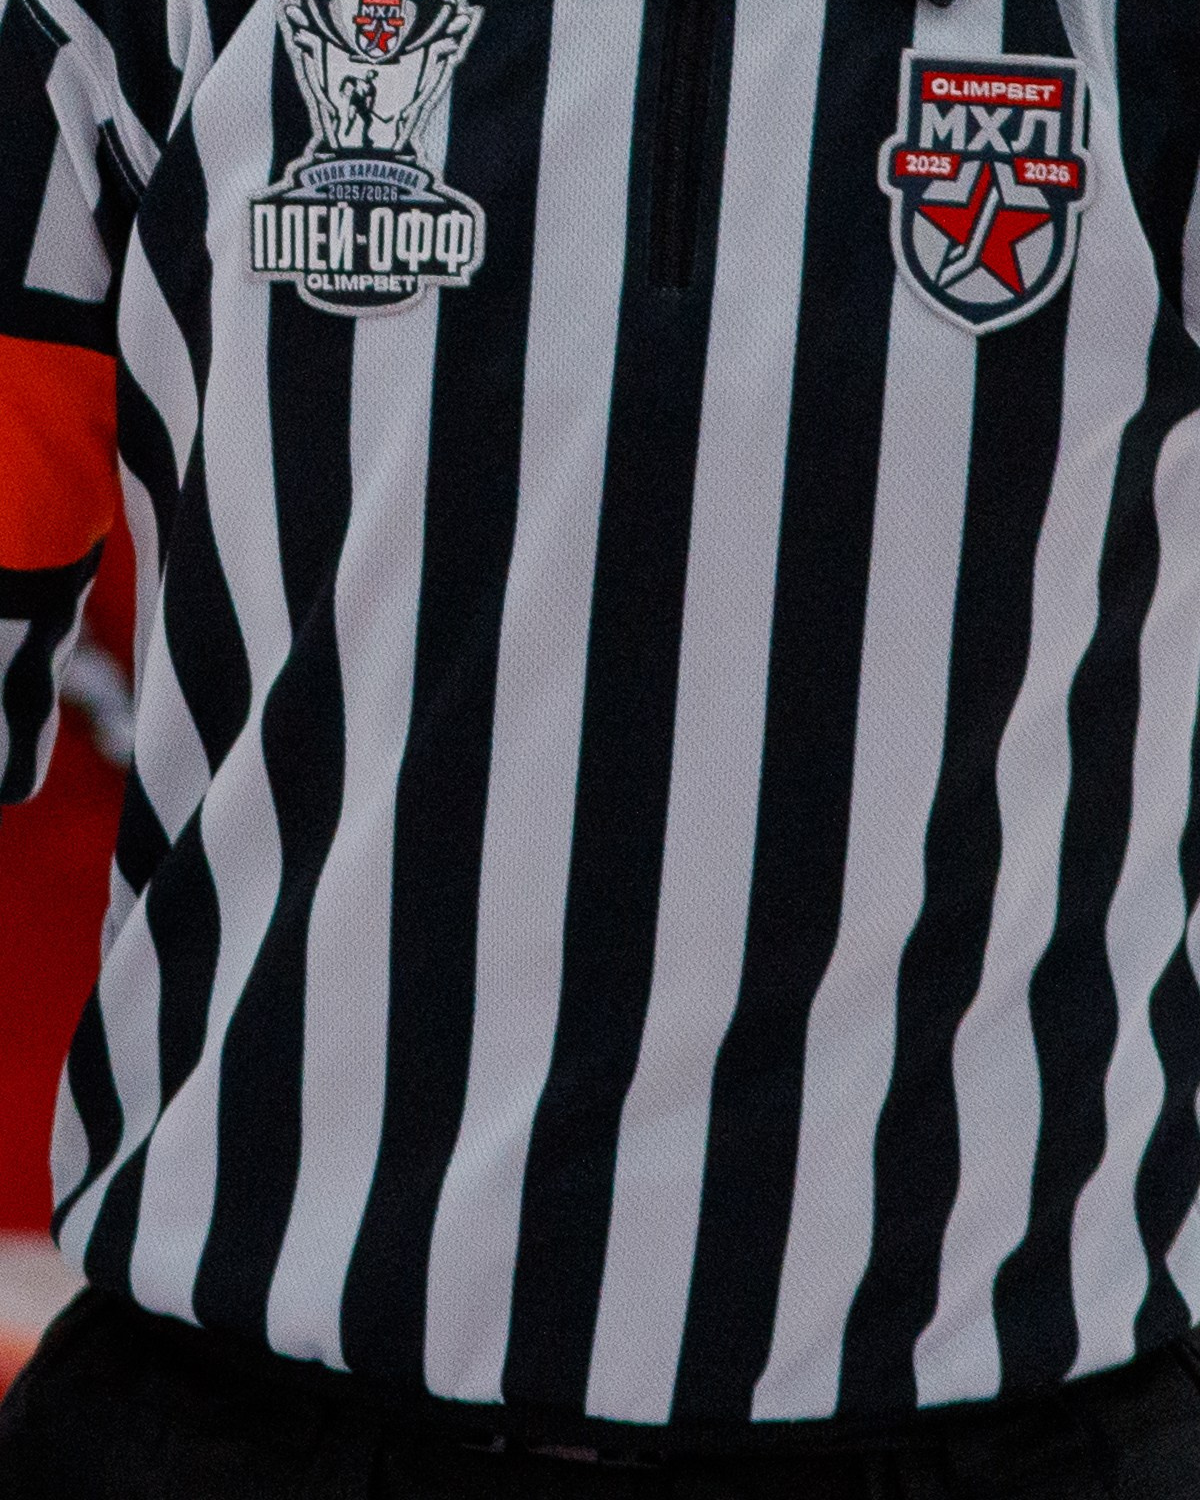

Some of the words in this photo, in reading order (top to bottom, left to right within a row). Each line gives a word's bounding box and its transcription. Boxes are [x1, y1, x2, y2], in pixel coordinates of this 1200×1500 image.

[362, 4, 400, 18] МХЛ
[931, 77, 1055, 100] OLIMPBET
[919, 102, 1061, 156] МХЛ
[906, 154, 951, 173] 2025
[1024, 162, 1071, 183] 2026
[328, 184, 398, 201] 2025/2026
[254, 202, 474, 273] ПЛЕЙ-ОФФ
[307, 273, 416, 292] OLIMPBET
